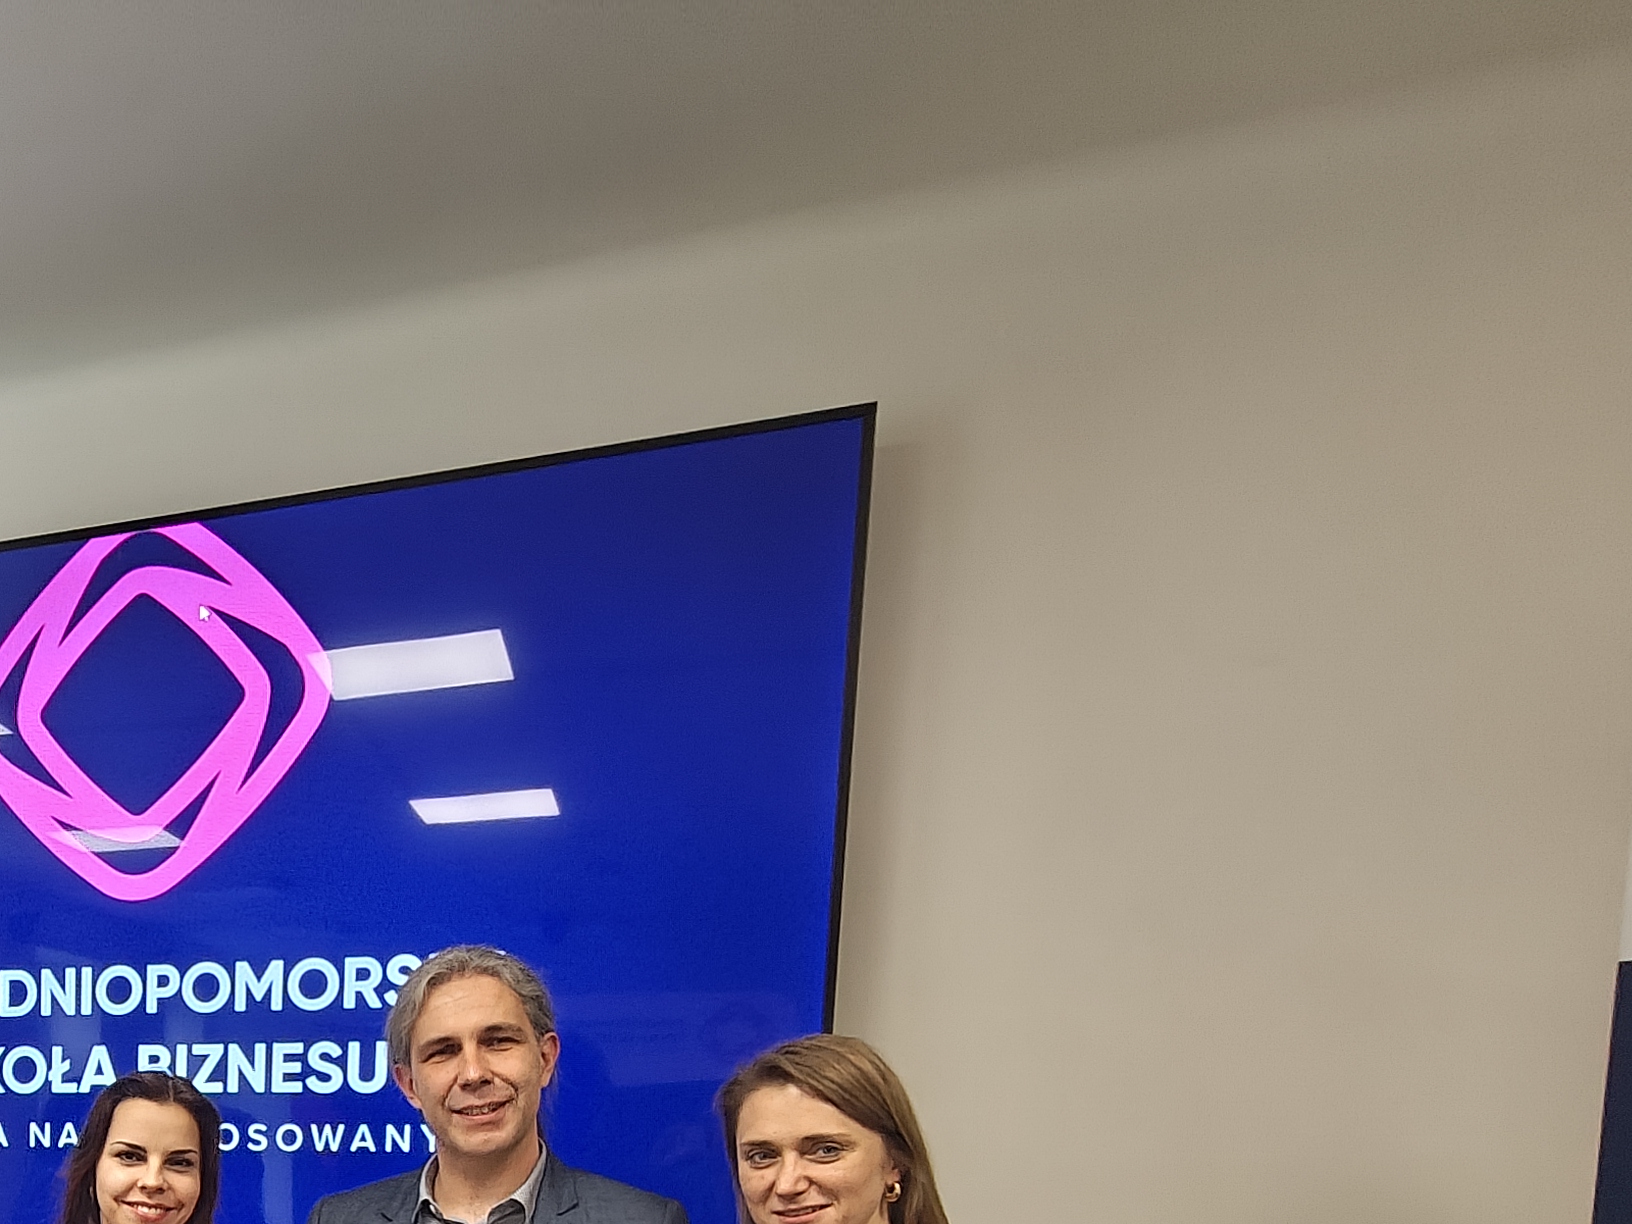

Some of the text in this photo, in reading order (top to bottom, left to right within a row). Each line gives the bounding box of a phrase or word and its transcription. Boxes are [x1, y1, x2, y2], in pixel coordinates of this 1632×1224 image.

[137, 1041, 389, 1095] BIZNESU
[28, 1121, 79, 1149] NA
[218, 1123, 437, 1153] OSOWANY
